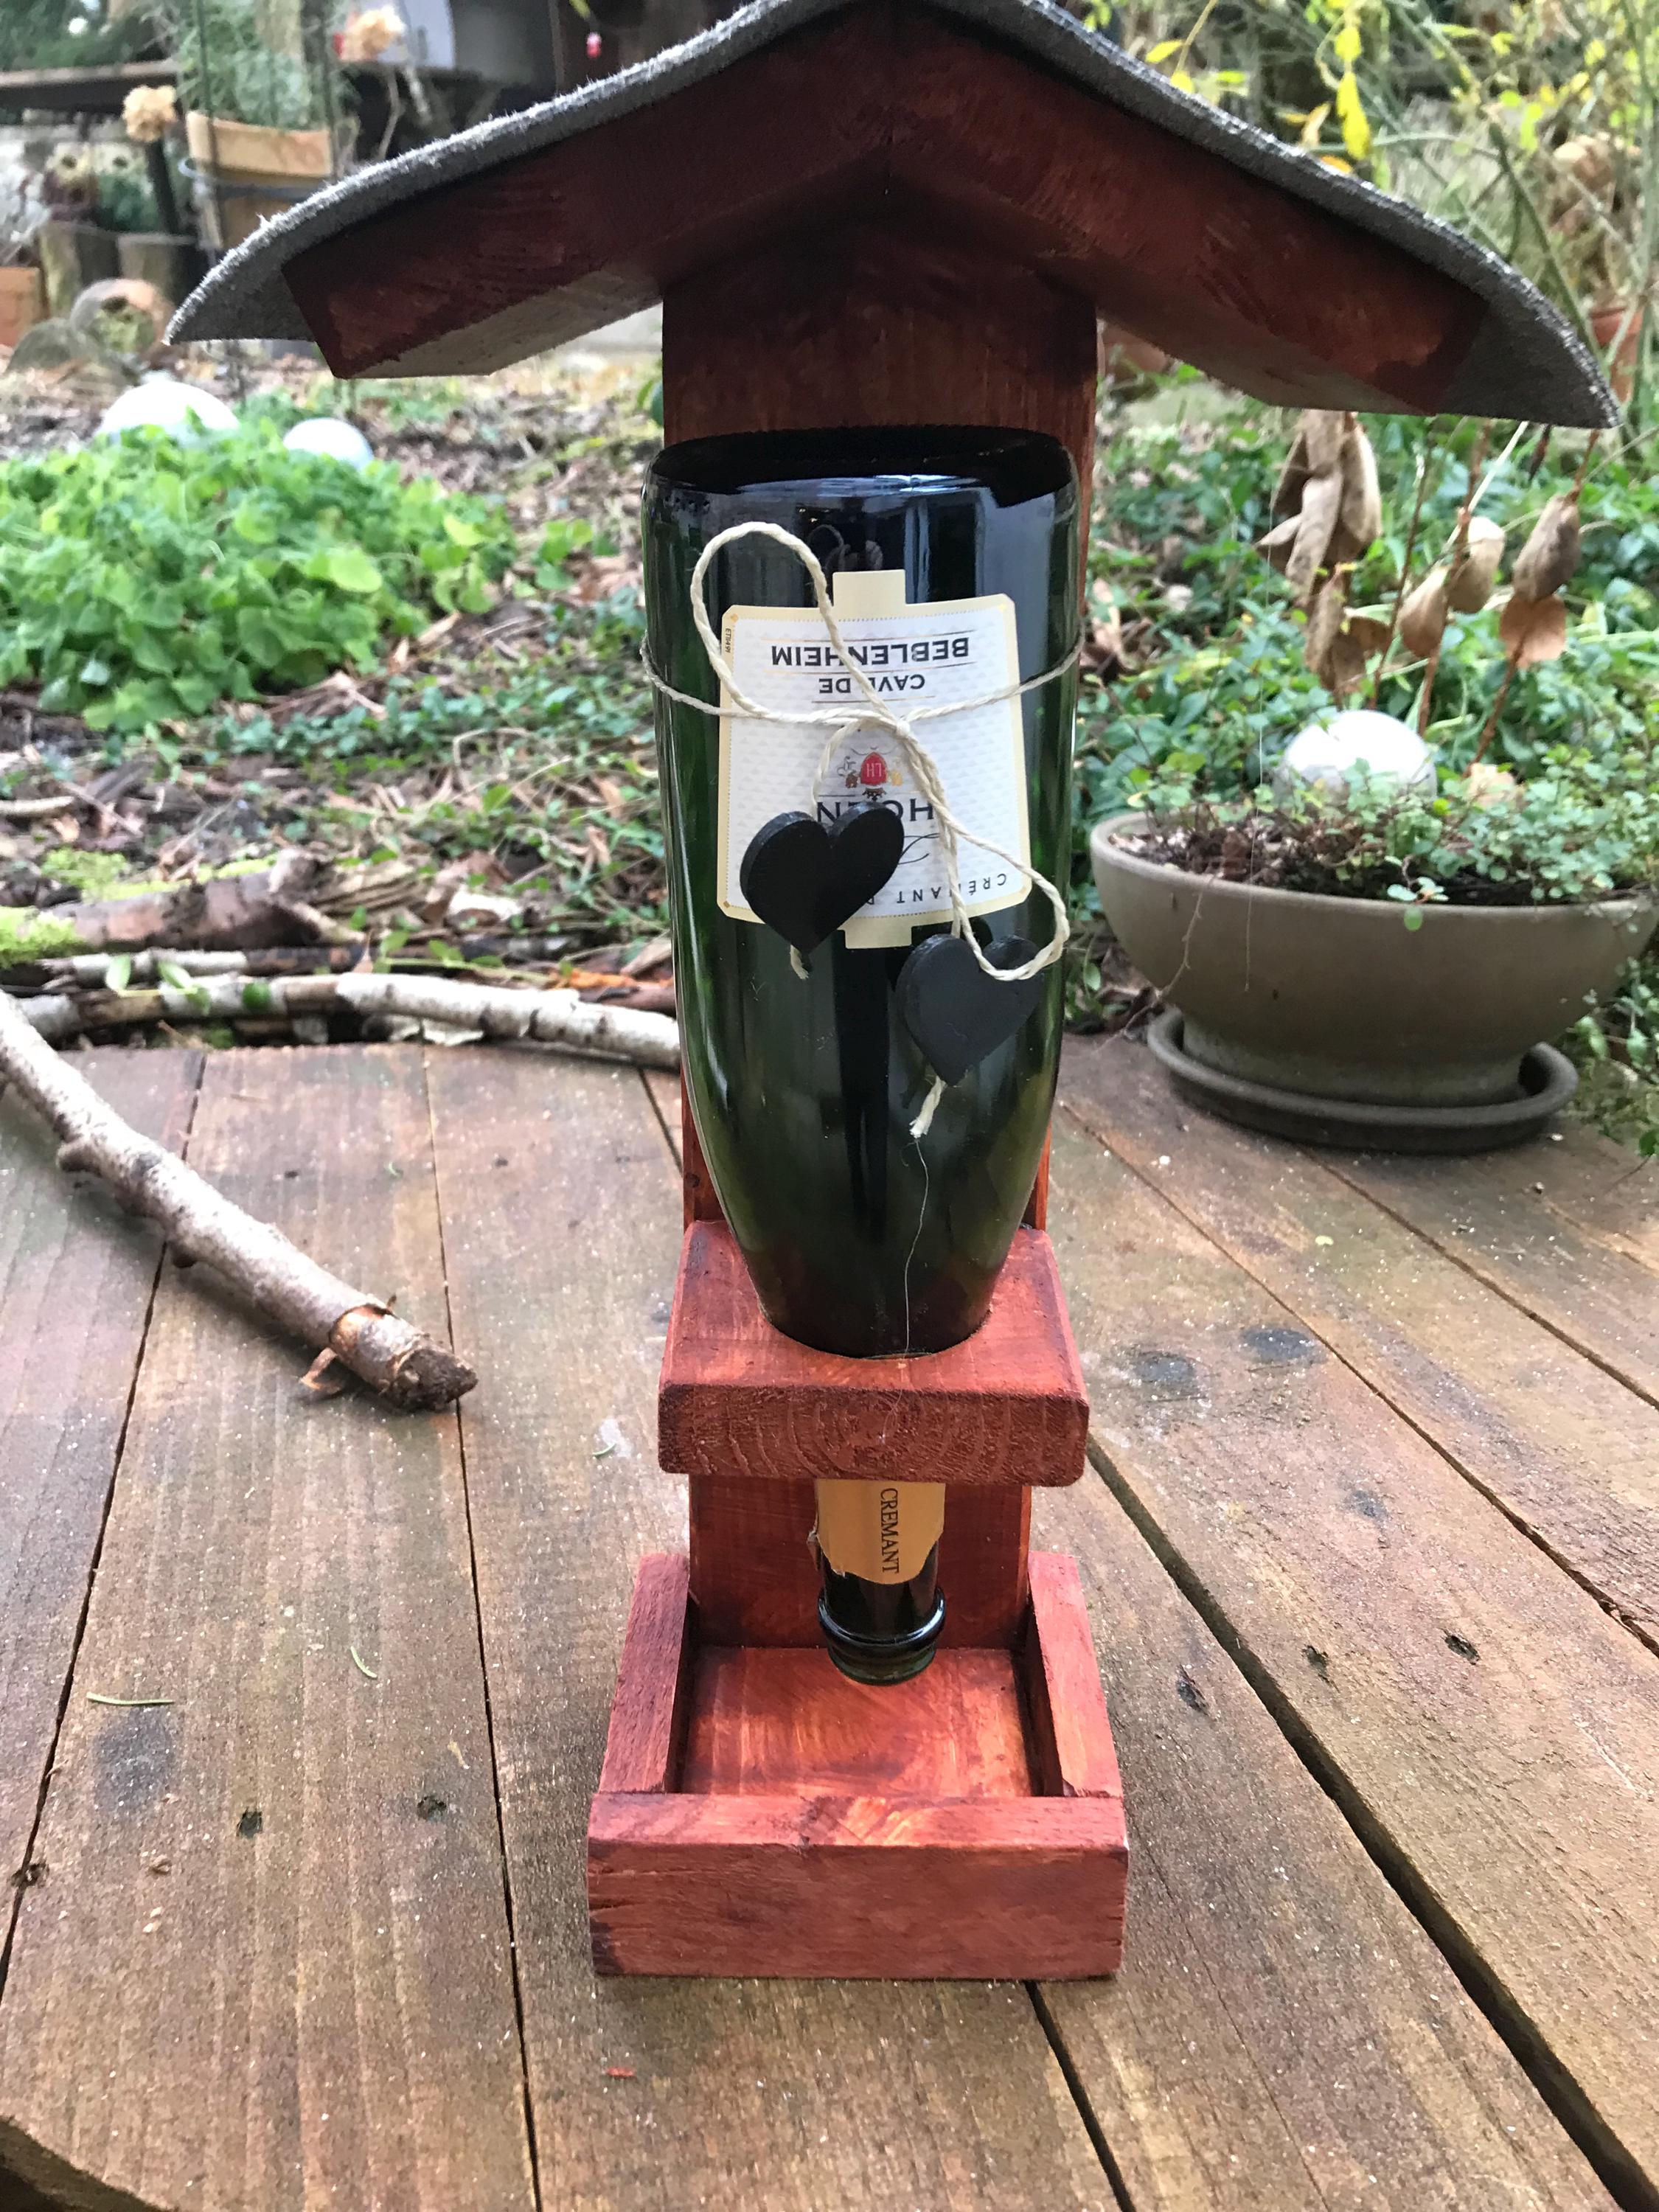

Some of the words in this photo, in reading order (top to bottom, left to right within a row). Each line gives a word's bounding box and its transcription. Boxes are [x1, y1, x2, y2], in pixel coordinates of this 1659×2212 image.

[772, 637, 970, 667] BEBLENHEIM
[818, 678, 851, 694] DE
[866, 762, 882, 778] LH
[880, 1487, 900, 1573] CREMANT
